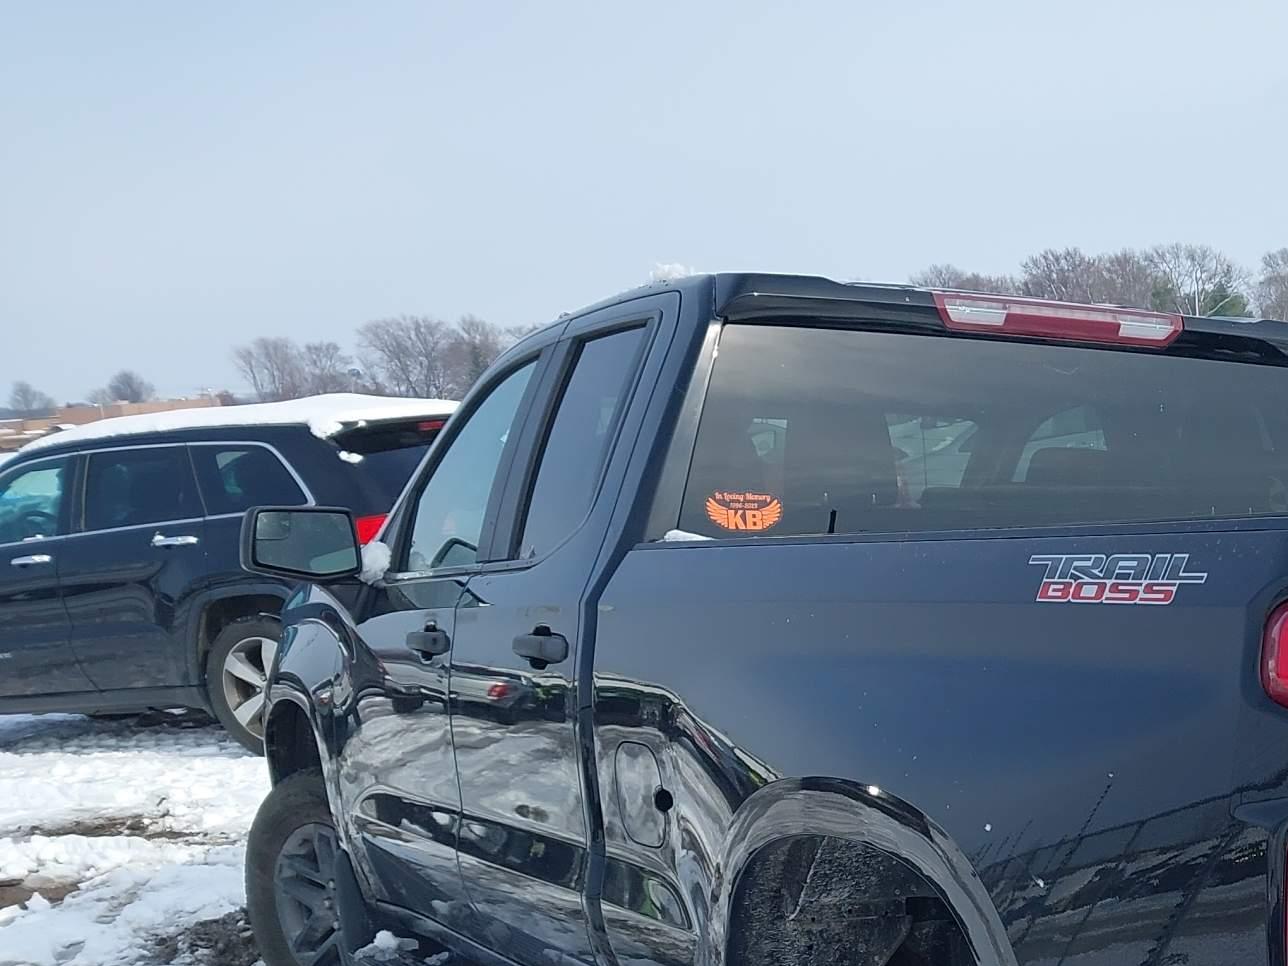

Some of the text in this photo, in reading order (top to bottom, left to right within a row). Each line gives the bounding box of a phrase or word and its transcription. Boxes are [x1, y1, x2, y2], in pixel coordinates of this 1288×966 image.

[727, 509, 763, 530] KB
[1028, 553, 1208, 584] TRAIL
[1036, 580, 1180, 604] BOSS
